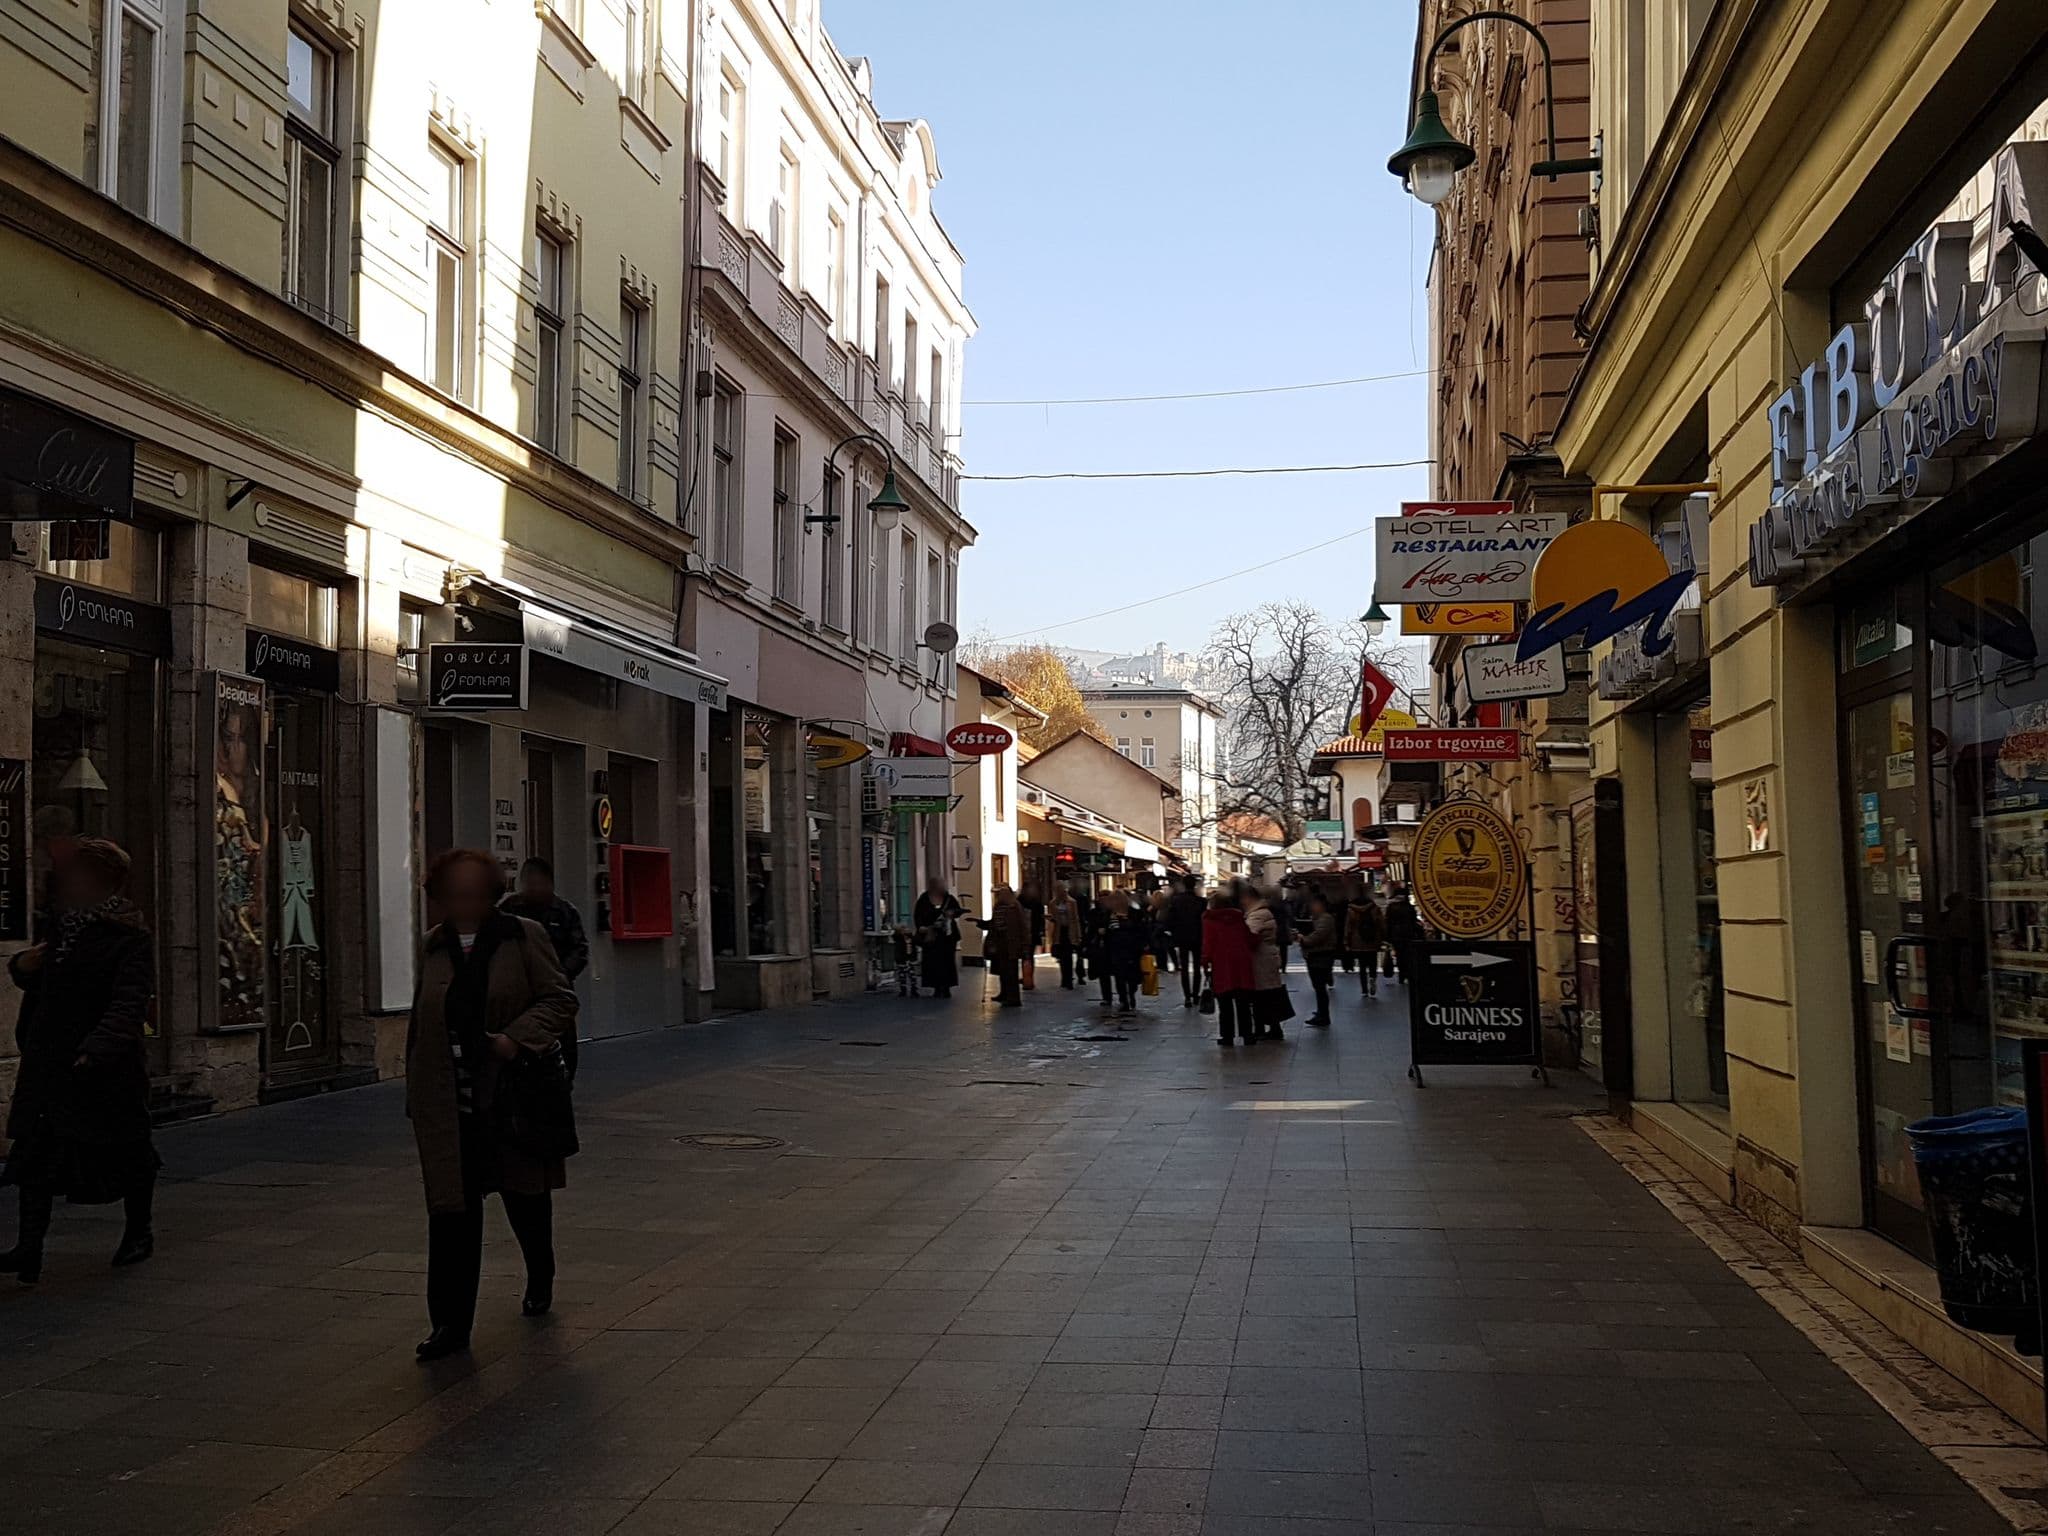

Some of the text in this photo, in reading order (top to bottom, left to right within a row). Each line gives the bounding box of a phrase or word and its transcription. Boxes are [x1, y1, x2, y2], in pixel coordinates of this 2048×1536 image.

[1767, 145, 2047, 506] FIBULA
[1783, 432, 1867, 561] Travel
[1877, 333, 2004, 499] Agency
[1389, 518, 1556, 535] HOTEL ART
[1391, 537, 1553, 554] RESTAURANT
[444, 650, 511, 665] OBUĆA
[1482, 660, 1549, 681] MAHIR
[952, 731, 1007, 745] Astra
[1388, 736, 1432, 750] Izbor
[1437, 735, 1506, 754] trgovine
[1438, 809, 1475, 828] SPECIAL
[1476, 812, 1507, 842] EXPORT
[1424, 1003, 1524, 1027] GUINNESS
[1444, 1028, 1507, 1044] Sarajevo
